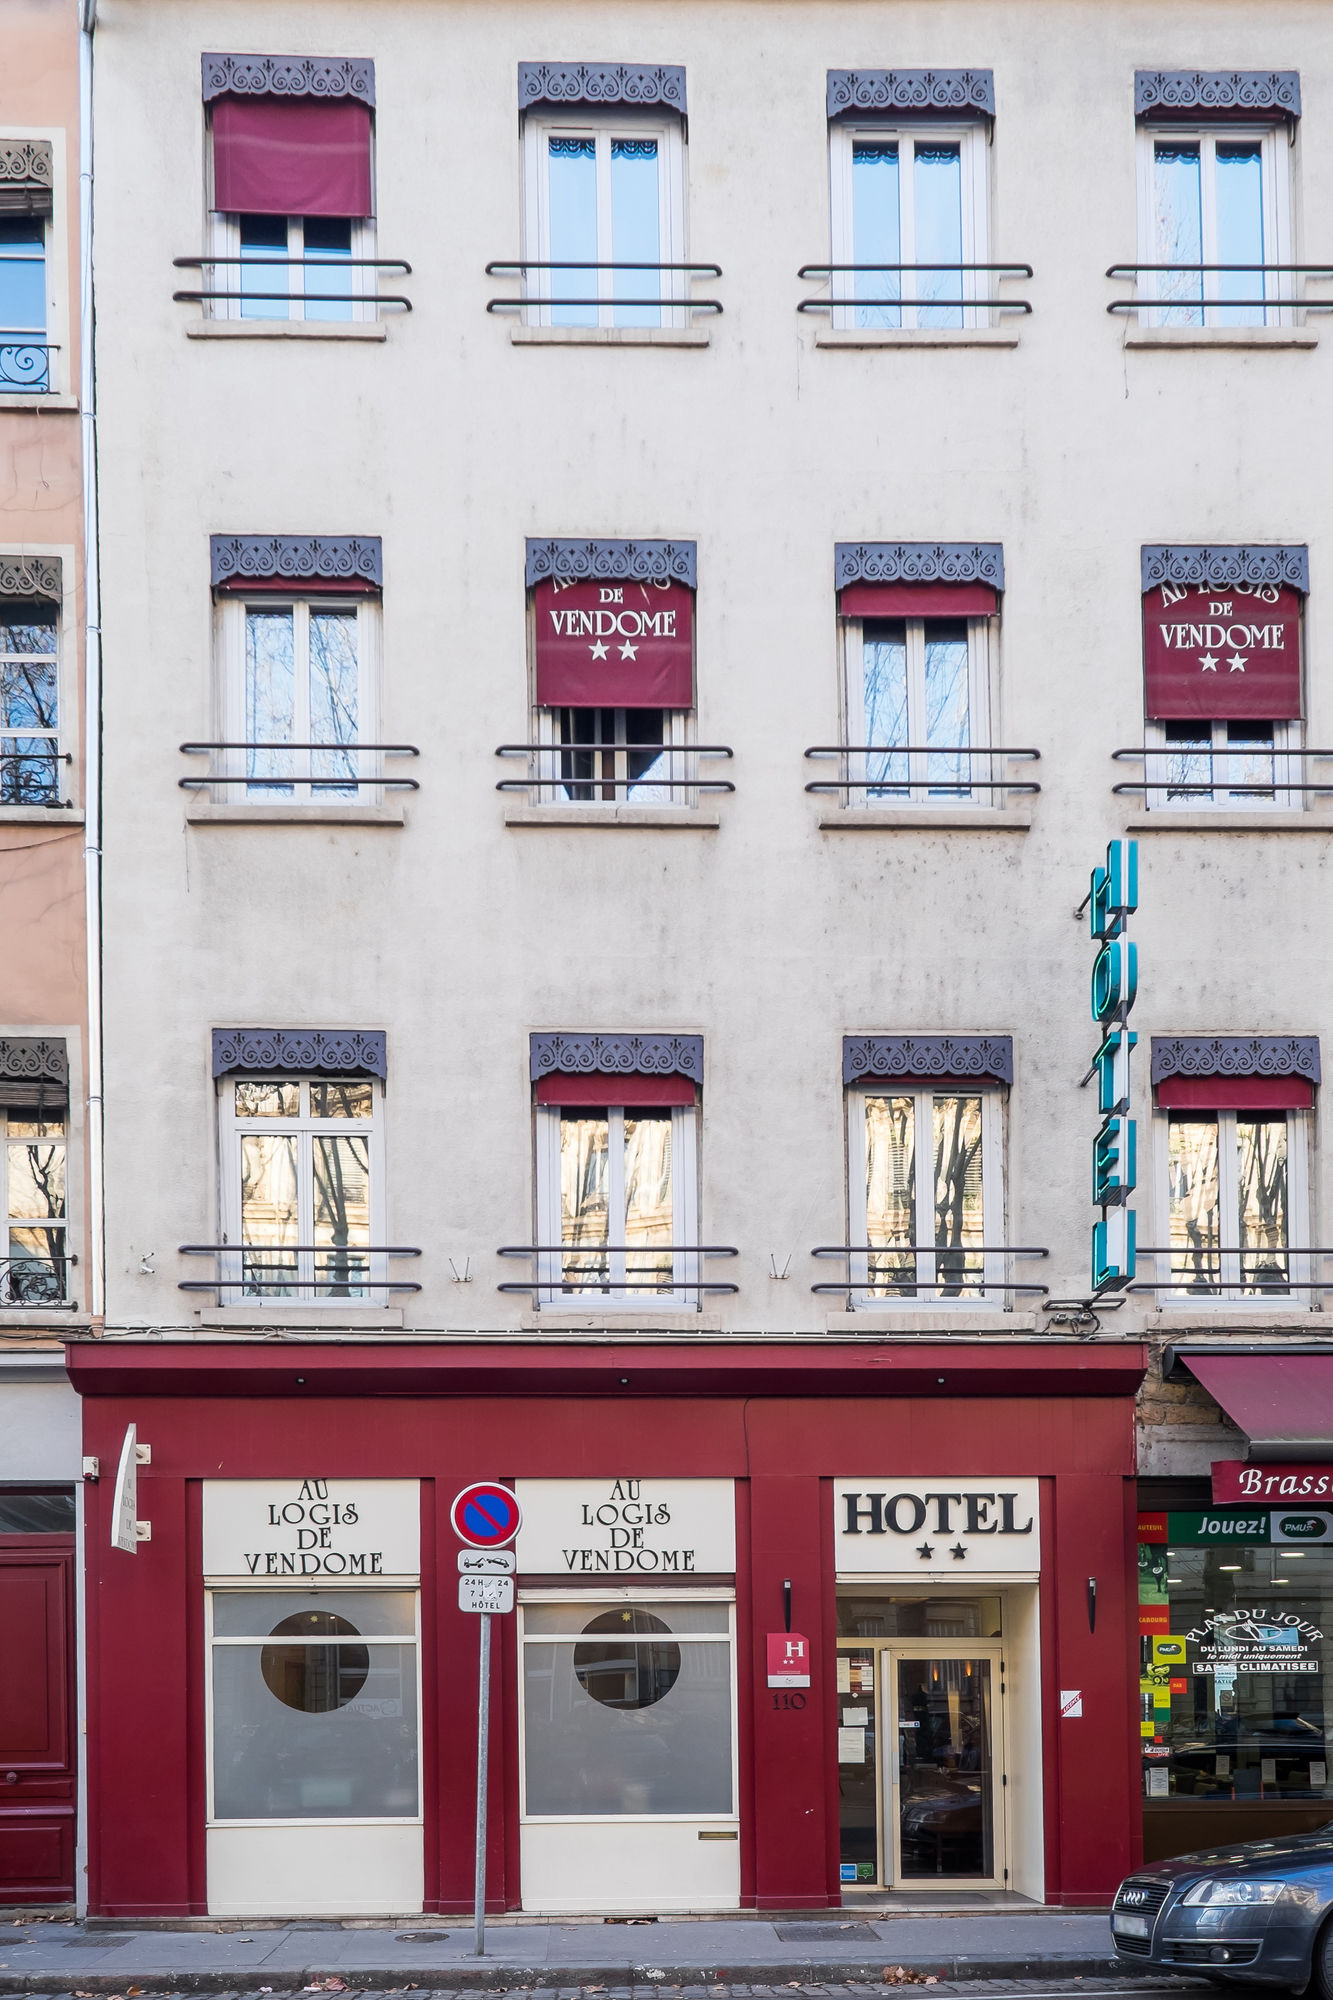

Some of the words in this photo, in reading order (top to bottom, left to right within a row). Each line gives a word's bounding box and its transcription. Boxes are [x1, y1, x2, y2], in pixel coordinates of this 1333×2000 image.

[600, 587, 623, 604] DE
[1209, 601, 1233, 616] DE
[550, 609, 676, 637] VENDOME
[1159, 623, 1285, 650] VENDOME
[297, 1478, 328, 1500] AU
[609, 1479, 641, 1500] AU
[1239, 1468, 1333, 1495] Brass
[268, 1503, 358, 1526] LOGIS
[582, 1503, 670, 1526] LOGIS
[842, 1493, 1033, 1534] HOTEL
[1197, 1517, 1266, 1534] Jouez!
[297, 1526, 331, 1550] DE
[610, 1526, 644, 1549] DE
[244, 1552, 383, 1575] VENDOME
[562, 1549, 695, 1571] VENDOME
[472, 1601, 500, 1609] HÔTEL
[1185, 1613, 1228, 1643] PLAT
[1233, 1608, 1267, 1621] DU
[1271, 1612, 1324, 1642] JOUR
[785, 1641, 804, 1657] H
[1200, 1645, 1215, 1653] DU
[1243, 1653, 1302, 1661] uniquement
[1196, 1663, 1237, 1672] SAE
[1240, 1662, 1316, 1671] CLIMATISEE
[772, 1693, 807, 1710] 110
